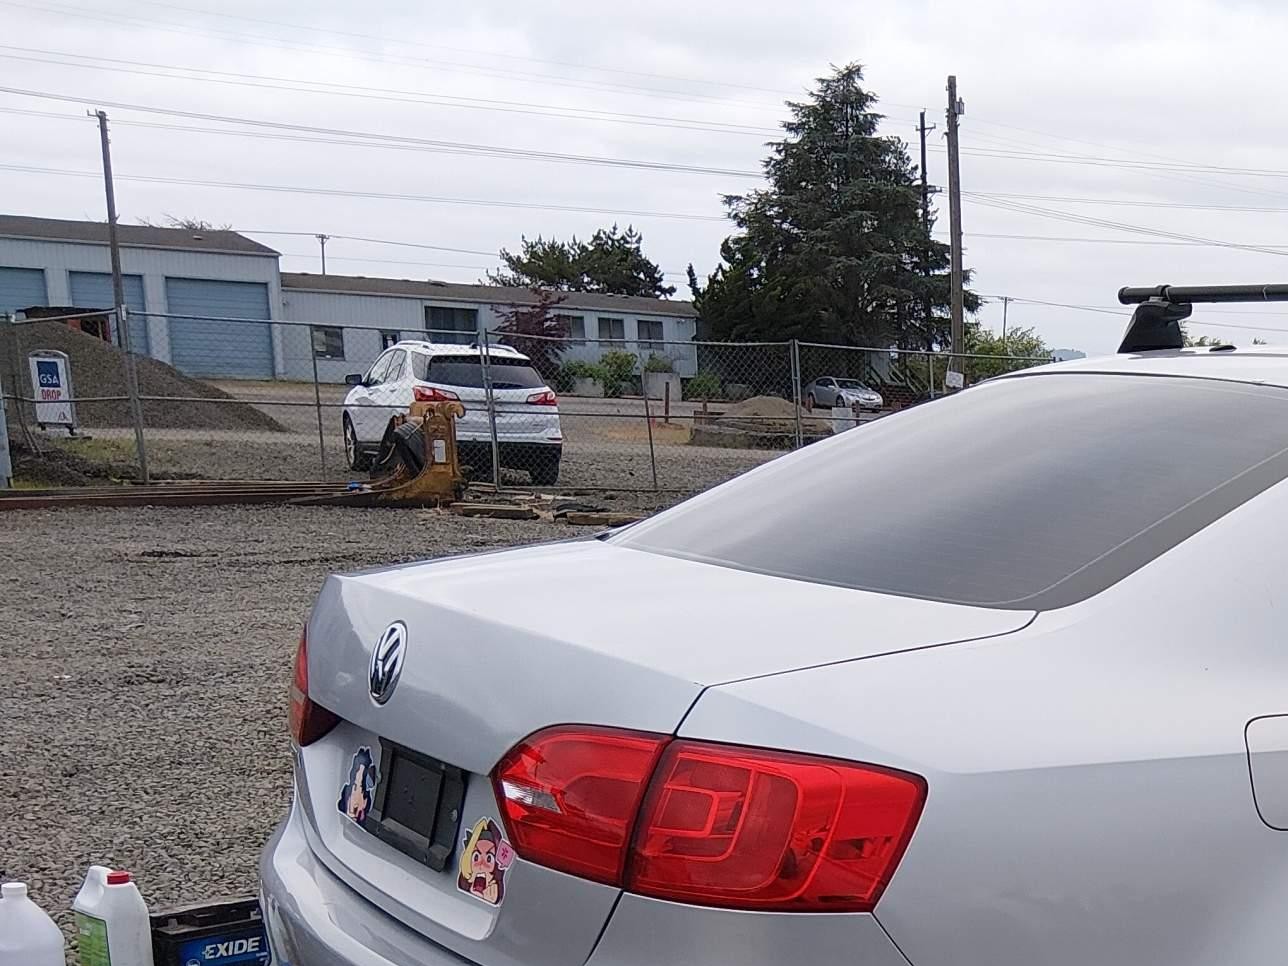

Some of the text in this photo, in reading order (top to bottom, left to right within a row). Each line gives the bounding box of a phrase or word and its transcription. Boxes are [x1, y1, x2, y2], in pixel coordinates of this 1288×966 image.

[39, 374, 60, 385] GSA
[41, 389, 62, 401] DROP
[202, 936, 261, 960] EXIDE
